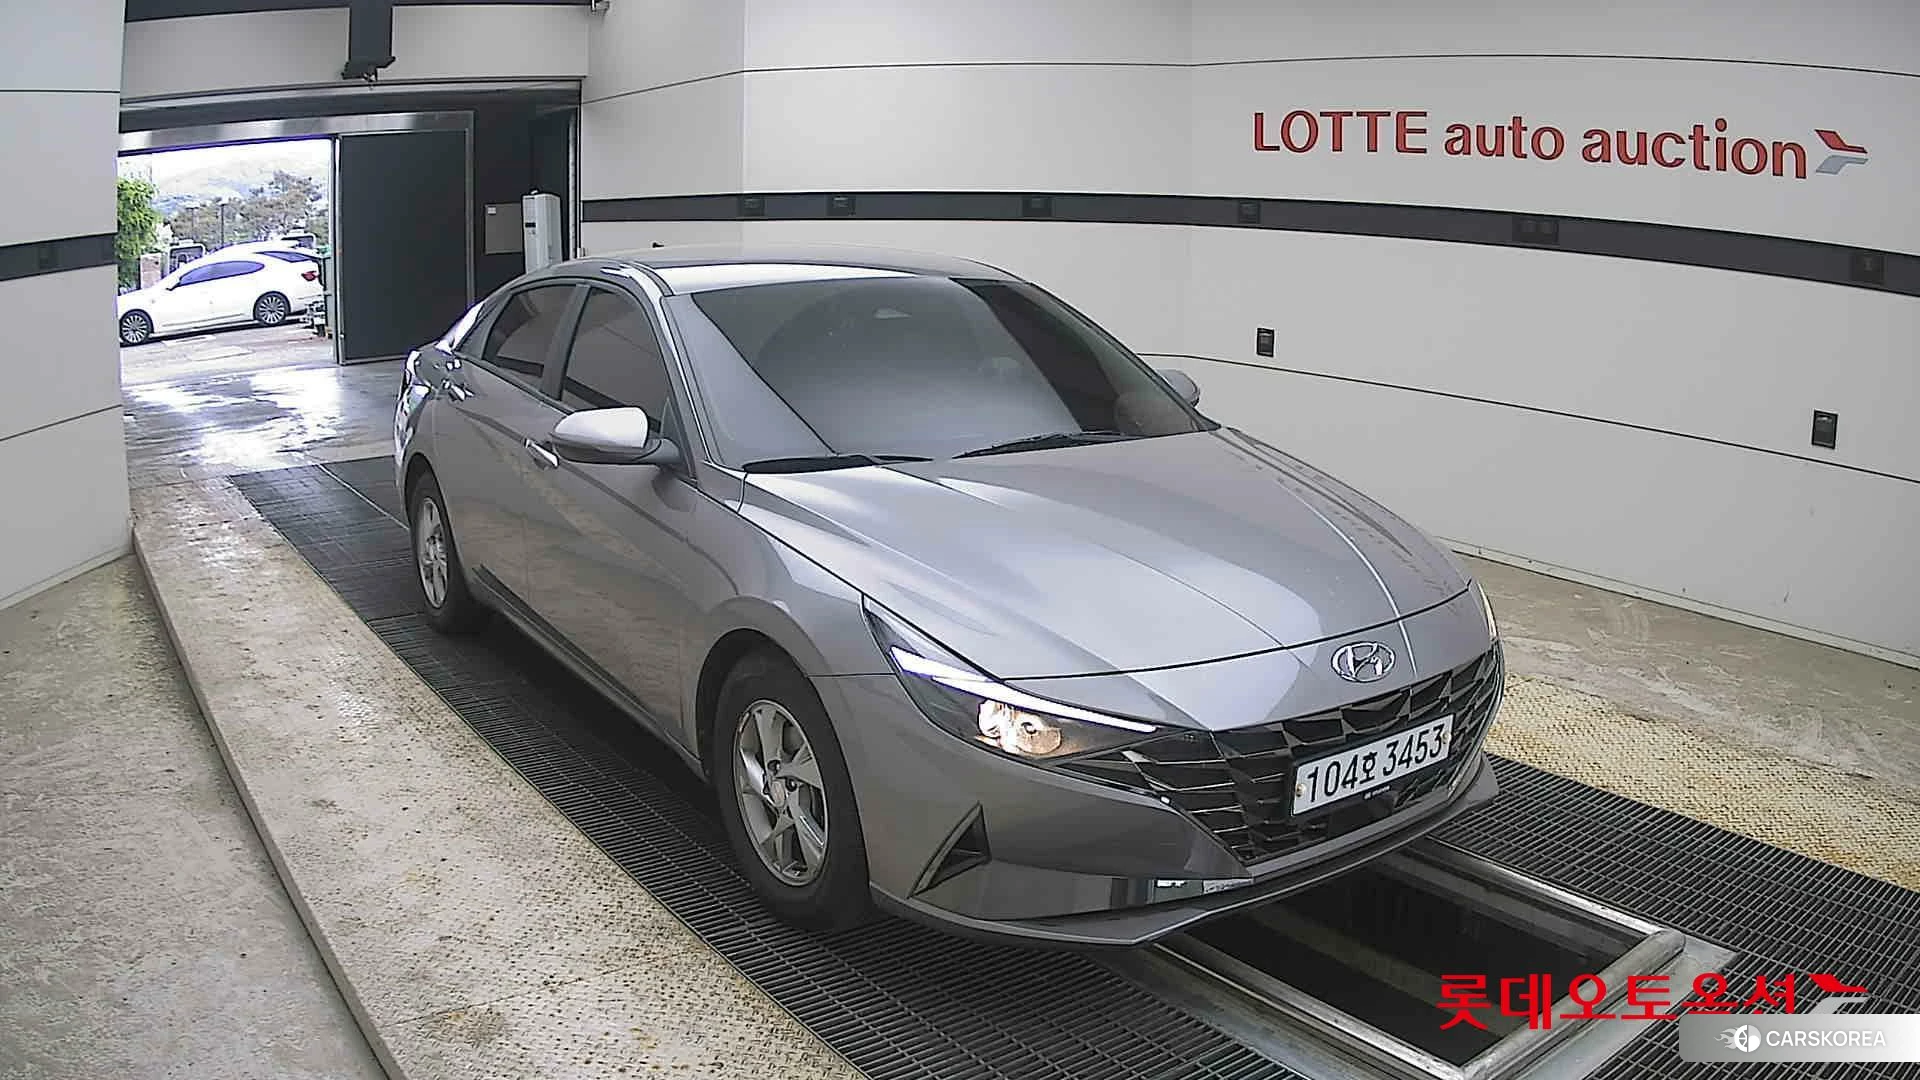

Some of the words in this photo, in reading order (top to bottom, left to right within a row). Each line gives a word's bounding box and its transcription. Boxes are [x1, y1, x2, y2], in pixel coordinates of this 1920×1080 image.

[1253, 111, 1428, 154] LOTTE
[1444, 116, 1566, 161] auto
[1582, 118, 1808, 179] auction
[1382, 723, 1446, 777] 3453
